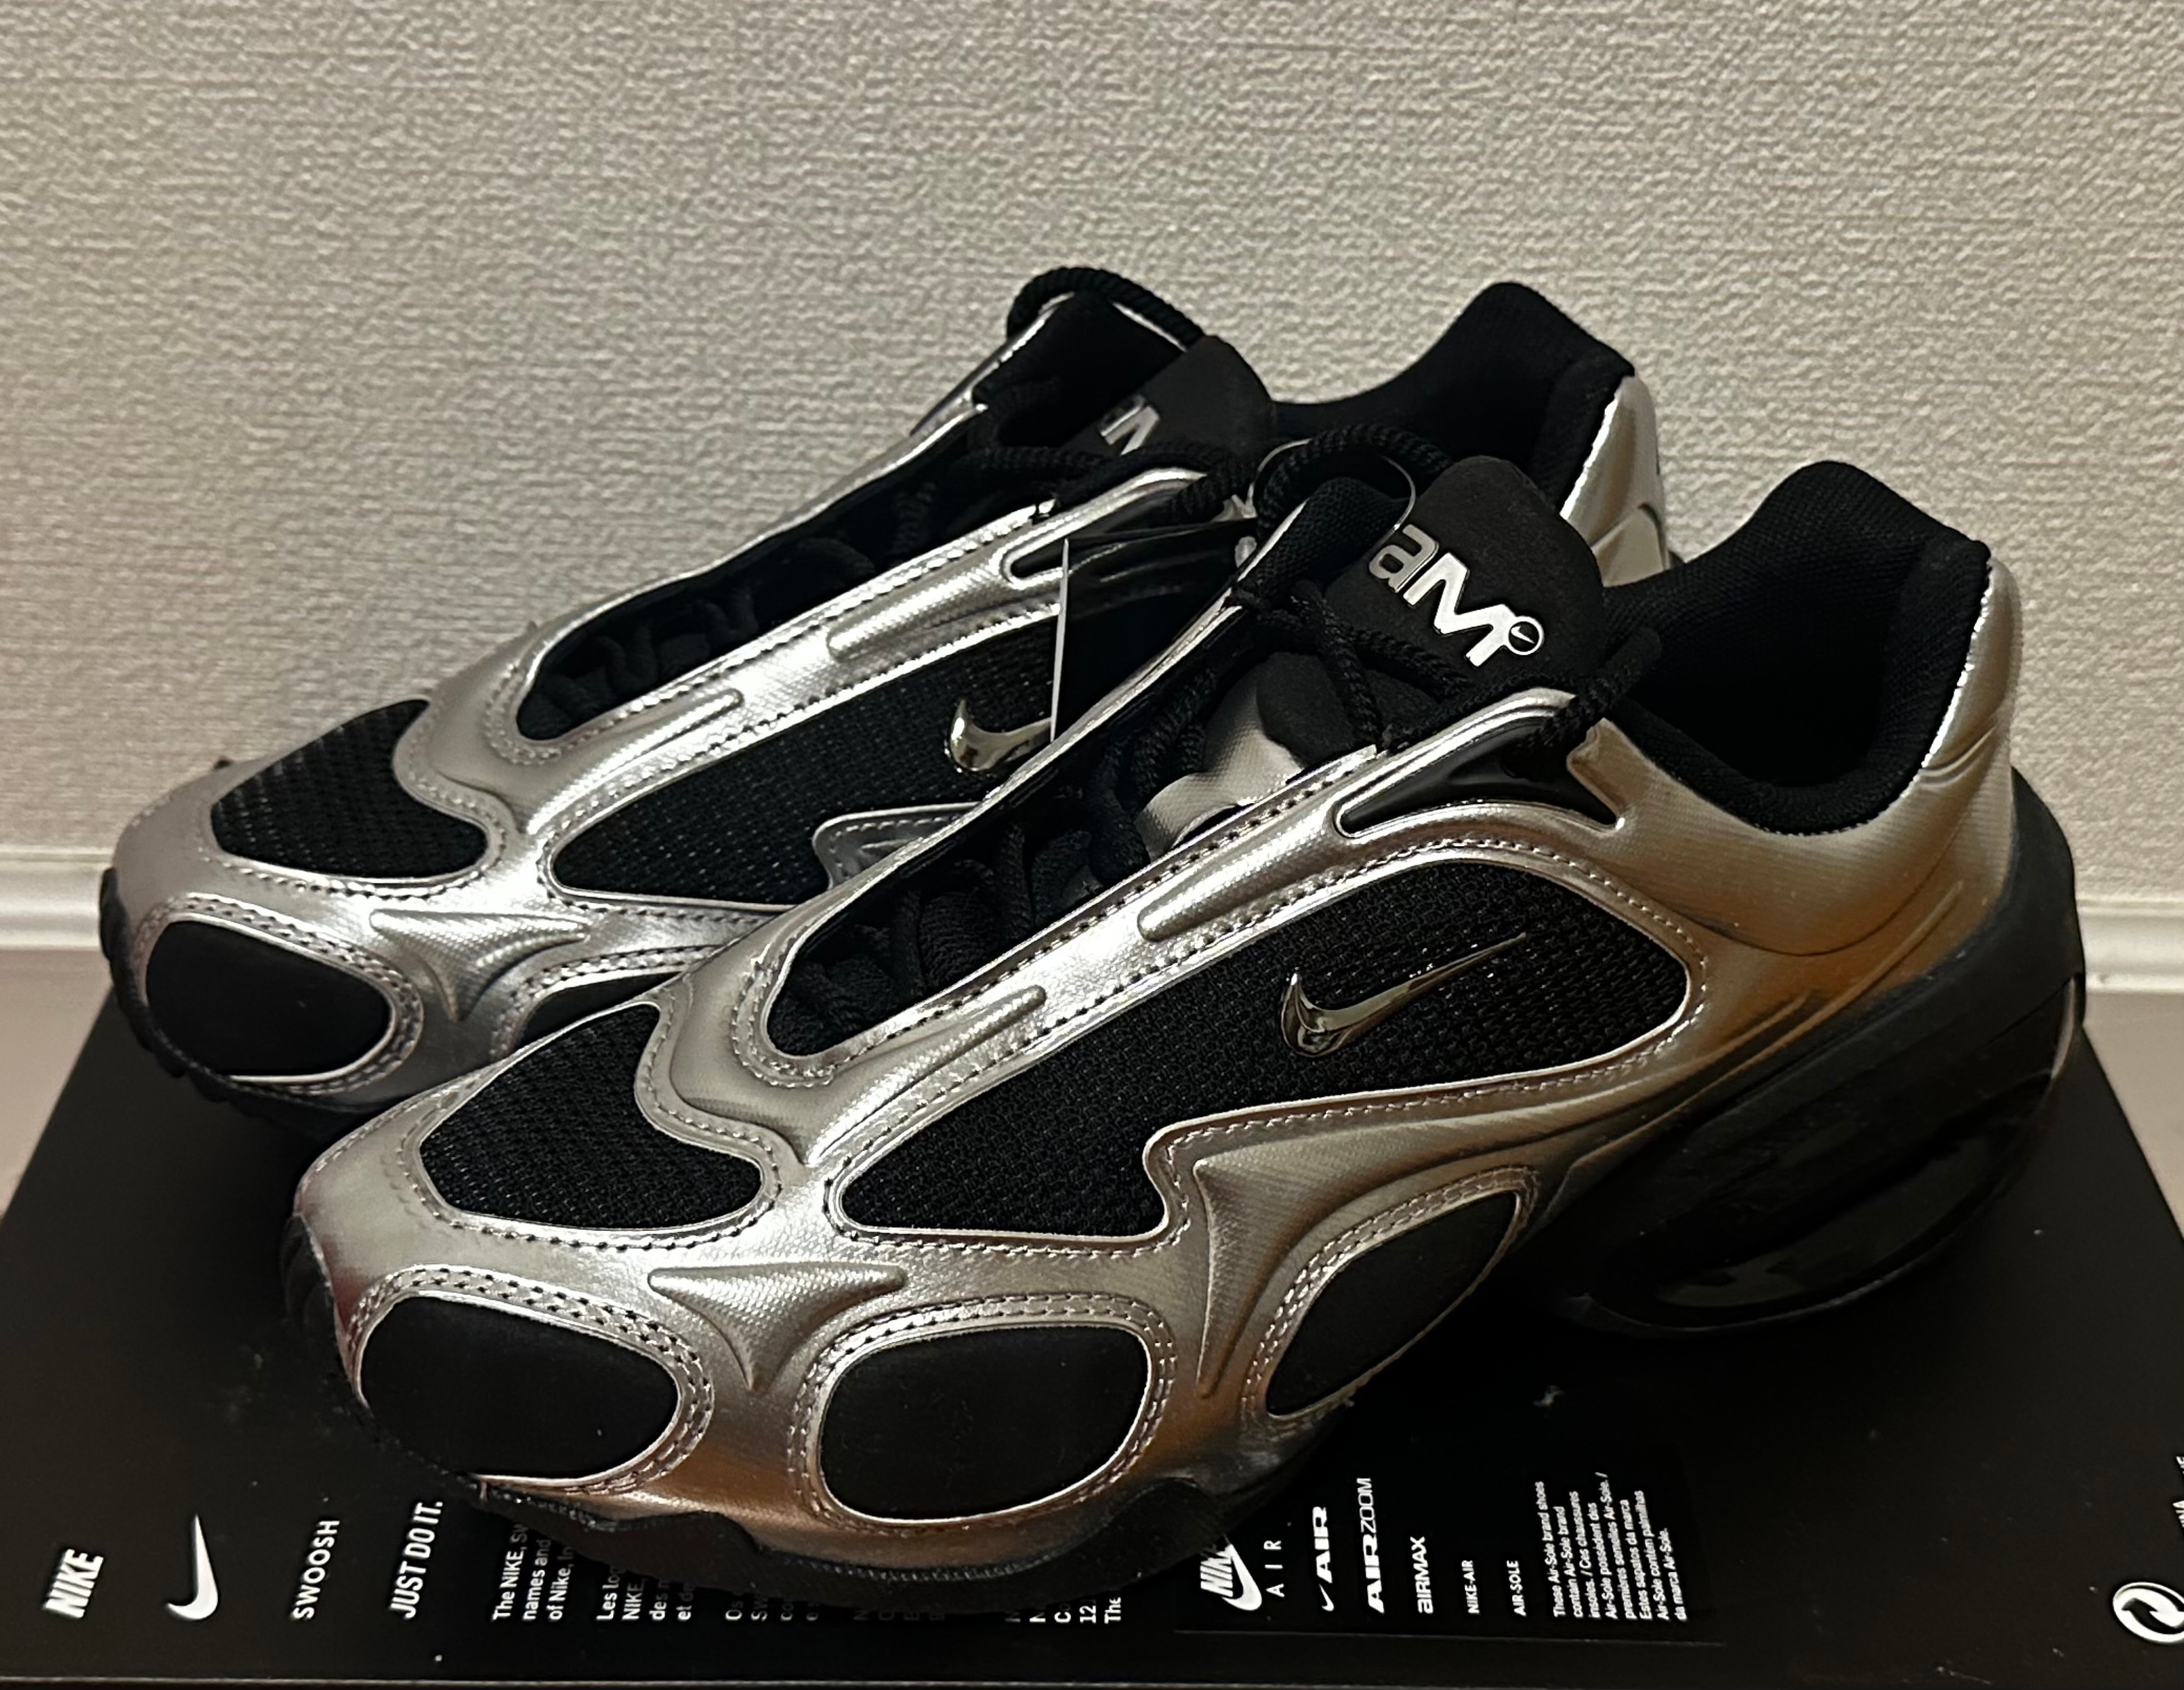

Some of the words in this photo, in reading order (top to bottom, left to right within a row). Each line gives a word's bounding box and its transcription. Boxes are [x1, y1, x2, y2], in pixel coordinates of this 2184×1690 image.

[414, 1501, 444, 1523] IT.
[1535, 1481, 1548, 1510] shoes
[1588, 1503, 1599, 1520] des
[1599, 1480, 1615, 1520] Air-Sole.
[1620, 1500, 1633, 1530] marca
[1634, 1490, 1655, 1537] palmilhas
[1538, 1512, 1553, 1541] brand
[1553, 1506, 1569, 1535] brand
[1569, 1491, 1588, 1547] chaussures
[1625, 1532, 1637, 1545] da
[403, 1527, 436, 1560] DO
[1312, 1506, 1333, 1583] AIR
[1544, 1543, 1561, 1583] Air-Sole
[1559, 1537, 1576, 1577] Air-Sole
[1579, 1548, 1591, 1569] Ces
[1608, 1522, 1624, 1565] semelles
[1658, 1528, 1676, 1570] Air-Sole.
[42, 1548, 103, 1619] NIKE
[292, 1519, 339, 1620] SWOOSH
[500, 1546, 528, 1589] NIKE,
[523, 1569, 545, 1621] names
[534, 1539, 552, 1566] and
[548, 1564, 574, 1602] Nike,
[1264, 1540, 1285, 1598] AIR
[1461, 1560, 1480, 1614] NIKE-AIR
[1629, 1547, 1646, 1588] sapatos
[1668, 1571, 1683, 1604] marca
[388, 1563, 427, 1619] JUST
[493, 1591, 514, 1621] The
[596, 1591, 617, 1621] Les
[649, 1592, 668, 1621] des
[1506, 1560, 1527, 1616] AIR-SOLE
[1552, 1585, 1566, 1617] These
[1566, 1578, 1584, 1618] contain
[1585, 1578, 1601, 1619] insoles.
[1602, 1578, 1618, 1619] Air-Sole
[1638, 1590, 1652, 1619] Estes
[1652, 1578, 1669, 1620] Air-Sole
[546, 1603, 564, 1621] of
[677, 1605, 692, 1621] et
[1674, 1606, 1687, 1621] da
